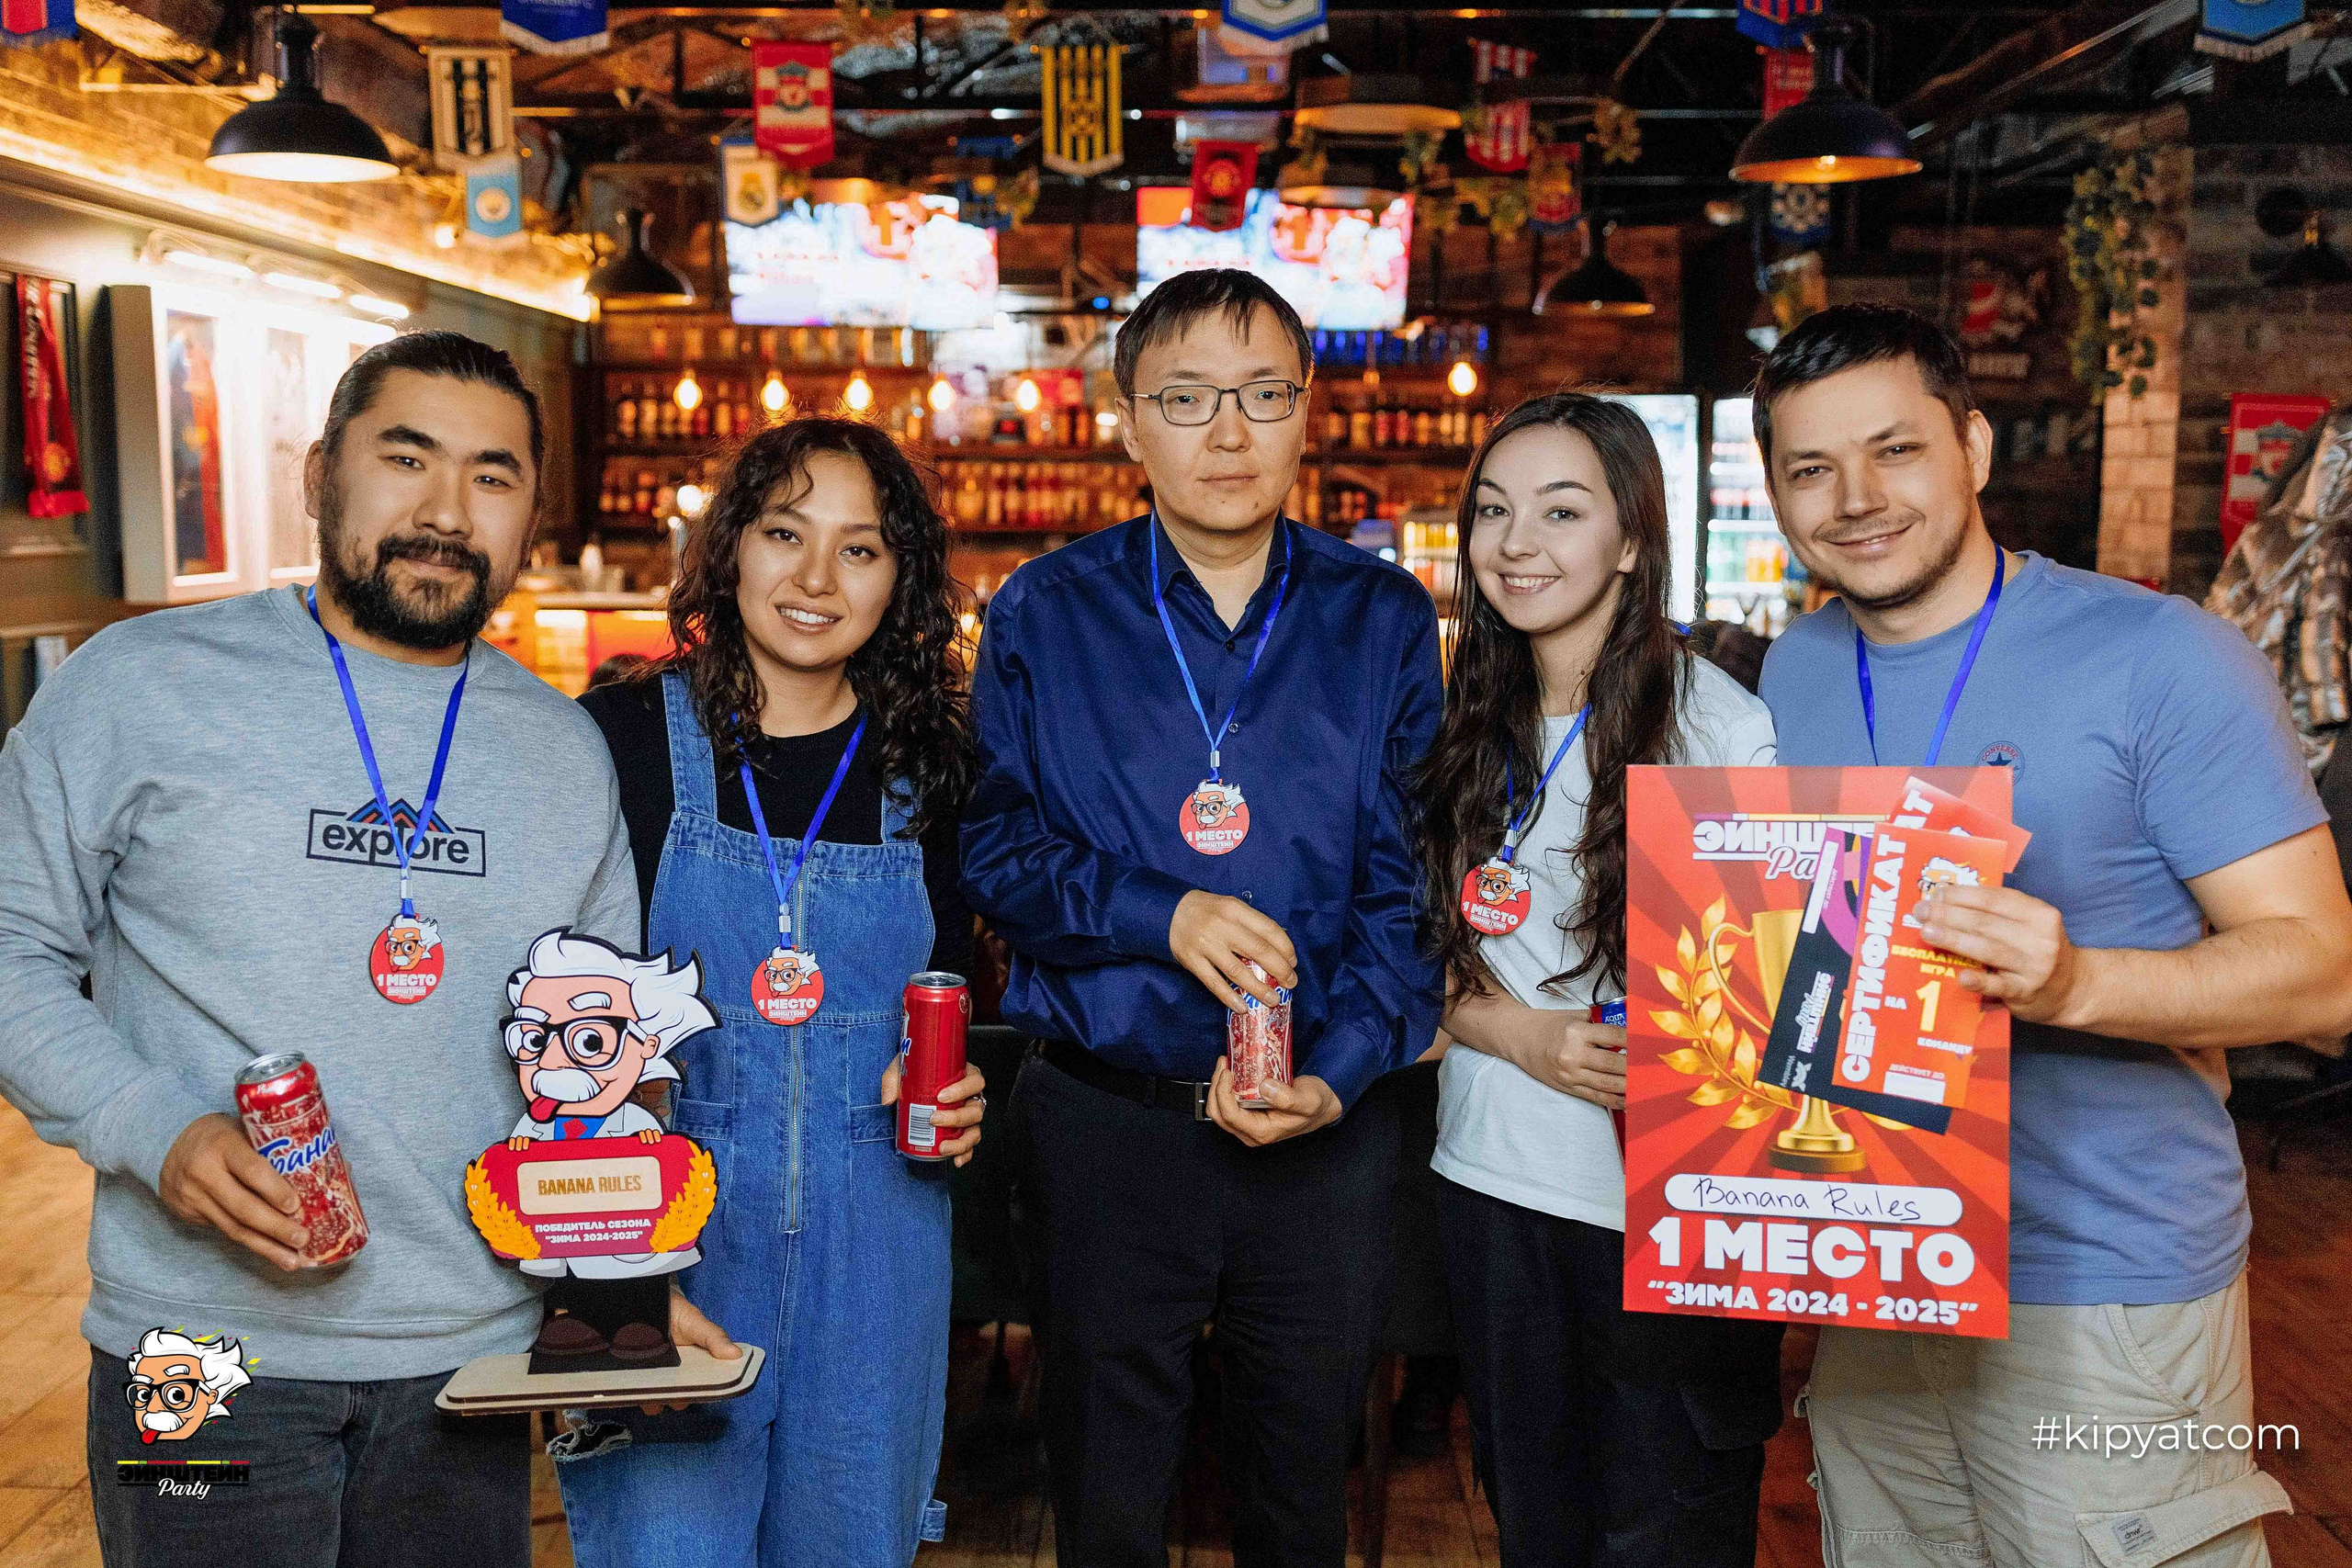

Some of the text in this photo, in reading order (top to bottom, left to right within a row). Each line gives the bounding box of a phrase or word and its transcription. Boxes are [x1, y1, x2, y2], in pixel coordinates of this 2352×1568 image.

[1982, 745, 2018, 761] CONVERSE
[322, 820, 469, 864] explore
[1186, 829, 1243, 841] 1 МЕСТО
[1463, 901, 1519, 926] 1 МЕСТО
[1841, 833, 1907, 1082] СЕРТИФИКАТ
[377, 974, 436, 987] 1 МЕСТО
[1920, 963, 1957, 979] ИГРА
[758, 998, 817, 1010] 1 МЕСТО
[1884, 979, 1941, 1032] НА 1
[1604, 1013, 1625, 1023] AQUA
[1780, 1055, 1796, 1087] Wembley
[537, 1176, 642, 1195] BANANA RULES
[1692, 1177, 1921, 1222] Banana Rules
[535, 1218, 651, 1233] ПОБЕДИТЕЛЬ СЕЗОНА
[1648, 1216, 1974, 1286] 1 МЕСТО
[1767, 1288, 1849, 1316] 2024
